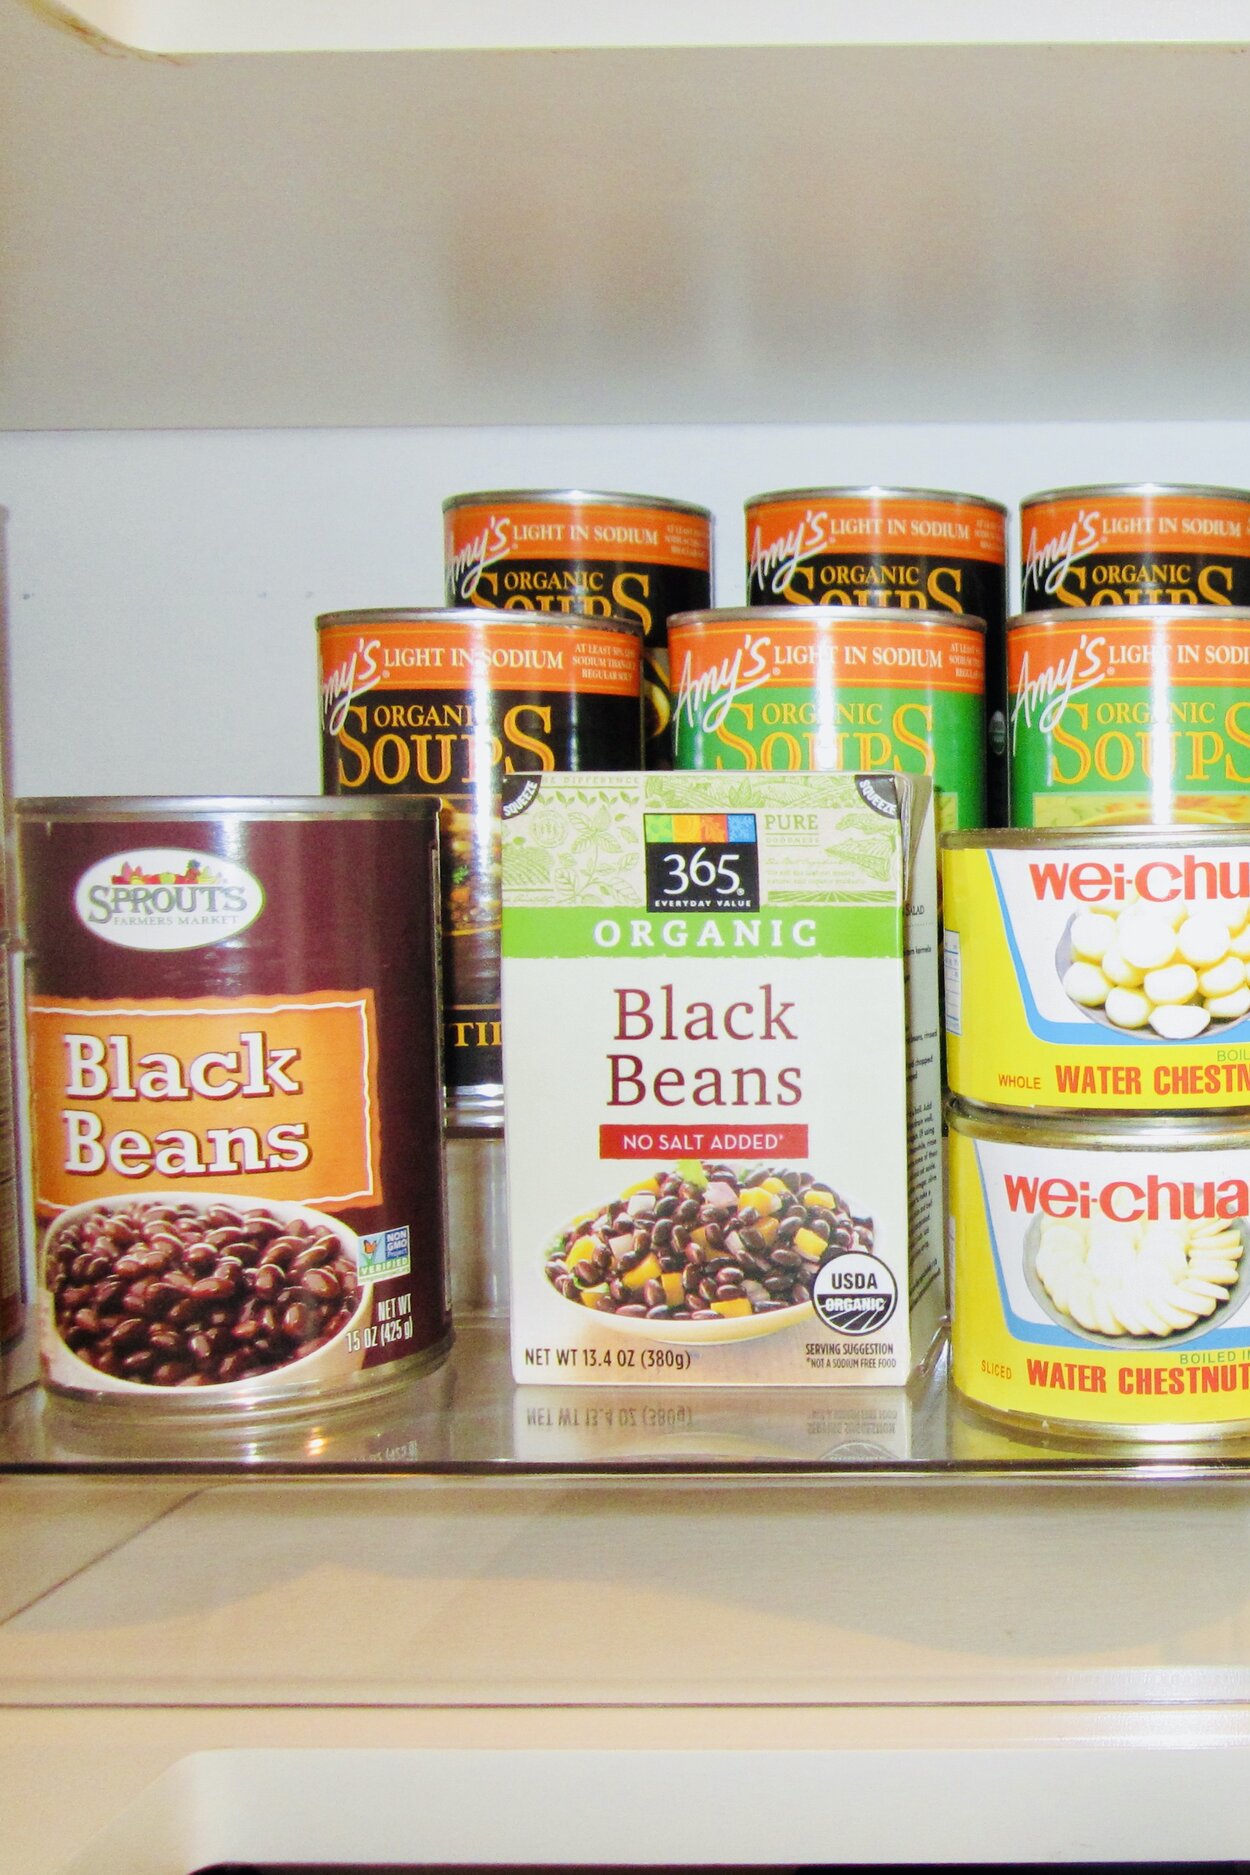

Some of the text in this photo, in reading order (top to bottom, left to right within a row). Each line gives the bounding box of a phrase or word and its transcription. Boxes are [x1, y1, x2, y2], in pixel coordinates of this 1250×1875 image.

[513, 524, 564, 542] LIGHT
[569, 525, 588, 542] IN
[593, 526, 659, 545] SODIUM
[830, 518, 882, 536] LIGHT
[887, 518, 906, 536] IN
[911, 519, 970, 540] SODIUM
[1101, 517, 1155, 535] LIGHT
[1158, 516, 1177, 534] IN
[1181, 517, 1242, 538] SODIUM
[503, 571, 604, 590] ORGANIC
[819, 565, 920, 586] ORGANIC
[1091, 564, 1192, 584] ORGANIC
[384, 647, 565, 670] LIGHT IN SODIUM
[844, 646, 868, 666] IN
[873, 647, 943, 669] SODIUM
[1176, 644, 1200, 664] IN
[373, 704, 480, 728] ORGANI
[761, 702, 883, 725] ORGNIC
[1095, 701, 1216, 725] ORGNIC
[502, 779, 538, 817] SQUEEZE
[858, 779, 898, 815] SQUEEZE
[764, 813, 819, 831] PURE
[663, 846, 742, 896] 365
[87, 884, 249, 925] SPROUTS
[654, 899, 752, 909] EVERYDAY VALUE
[112, 914, 240, 927] FARMERS MARKET
[592, 919, 818, 949] ORGANIC
[612, 983, 800, 1041] Black
[62, 1031, 303, 1101] Black
[605, 1053, 803, 1107] Beans
[997, 1073, 1042, 1090] WHOLE
[1054, 1064, 1142, 1096] WATER
[61, 1108, 313, 1179] Beans
[623, 1134, 654, 1151] NO
[659, 1134, 704, 1151] SALT
[387, 1228, 408, 1242] NON
[387, 1238, 408, 1252] GMO
[360, 1256, 409, 1275] VERIFIED
[830, 1272, 878, 1291] USDA
[377, 1292, 412, 1322] NET WT
[824, 1297, 886, 1313] ORGANIC
[346, 1315, 414, 1353] 15 OZ (425 g)
[524, 1347, 692, 1370] NET WT 13.4 OZ (380g)
[805, 1343, 894, 1356] SERVING SUGGESTION
[1179, 1350, 1237, 1365] BOILED
[825, 1358, 831, 1369] A
[832, 1358, 859, 1369] SODIUM
[860, 1358, 877, 1369] FREE
[878, 1358, 897, 1369] FOOD
[980, 1359, 1012, 1381] SLICED
[1026, 1358, 1107, 1394] WATER
